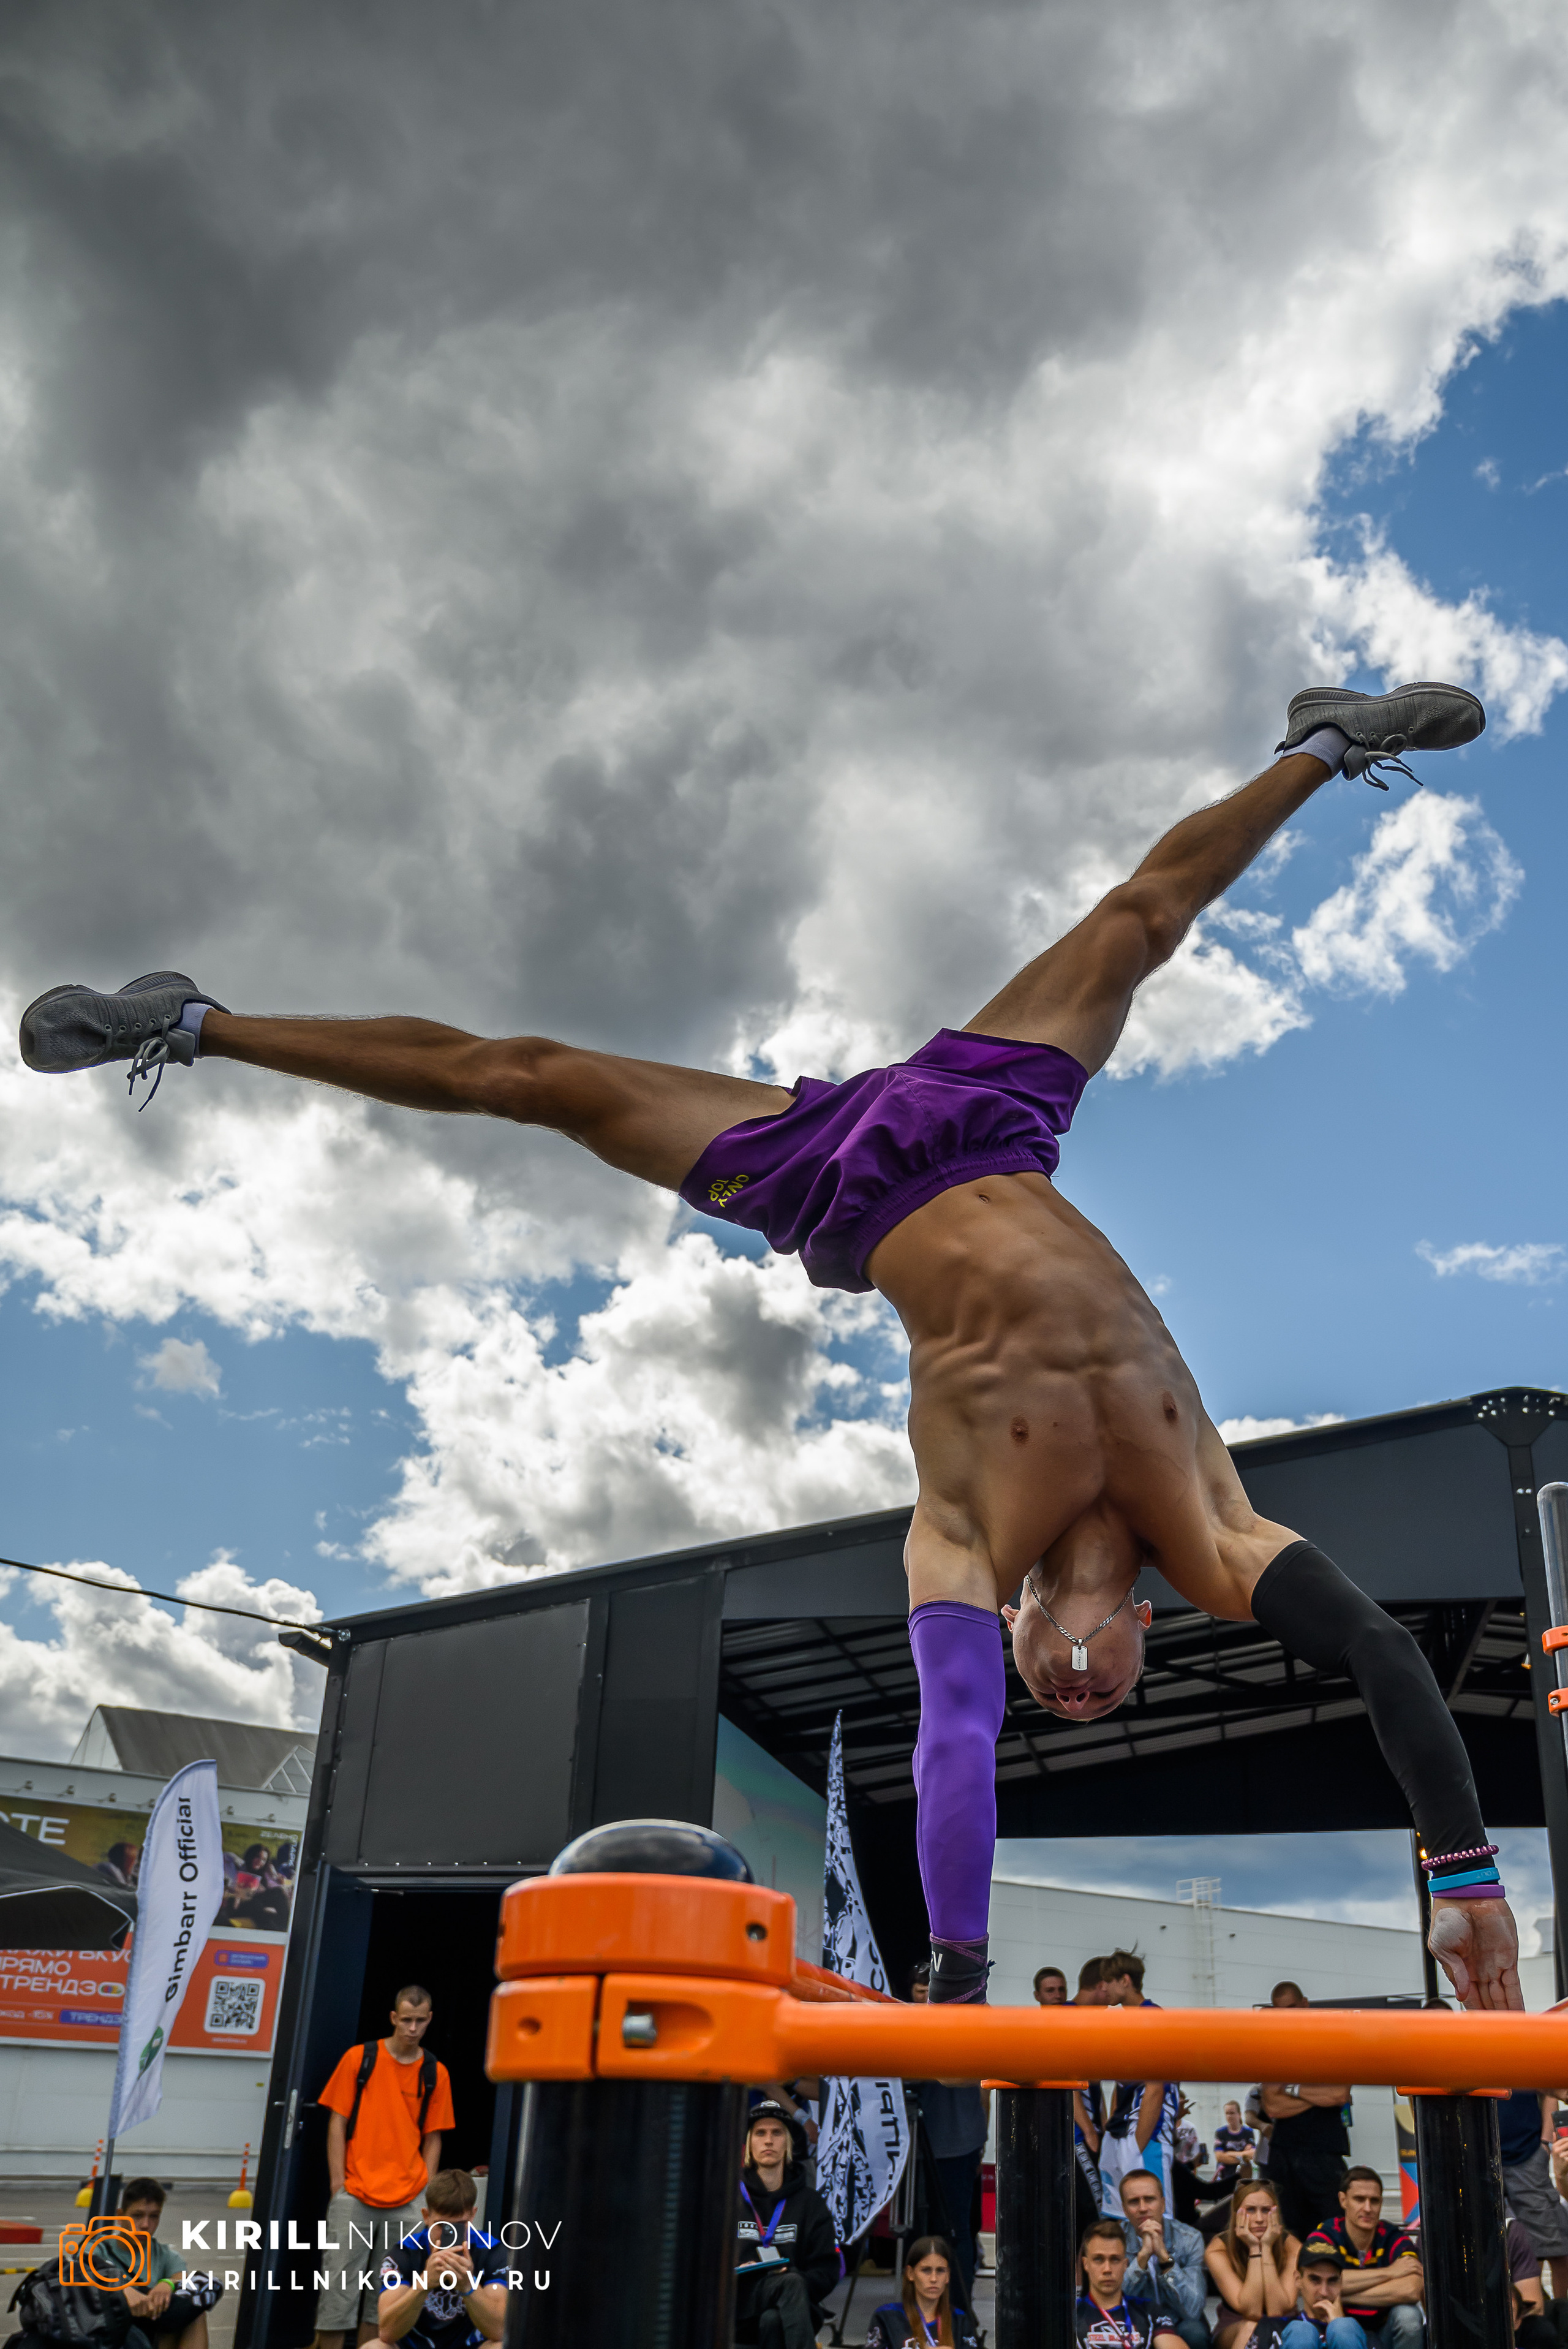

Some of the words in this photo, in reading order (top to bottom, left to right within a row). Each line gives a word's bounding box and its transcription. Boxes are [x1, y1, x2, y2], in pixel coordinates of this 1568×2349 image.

[708, 1179, 729, 1202] TOP
[718, 1174, 750, 1208] ONLY
[177, 1796, 199, 1882] Official
[165, 1891, 198, 2003] Gimbarr
[0, 1956, 71, 1976] РЯМО
